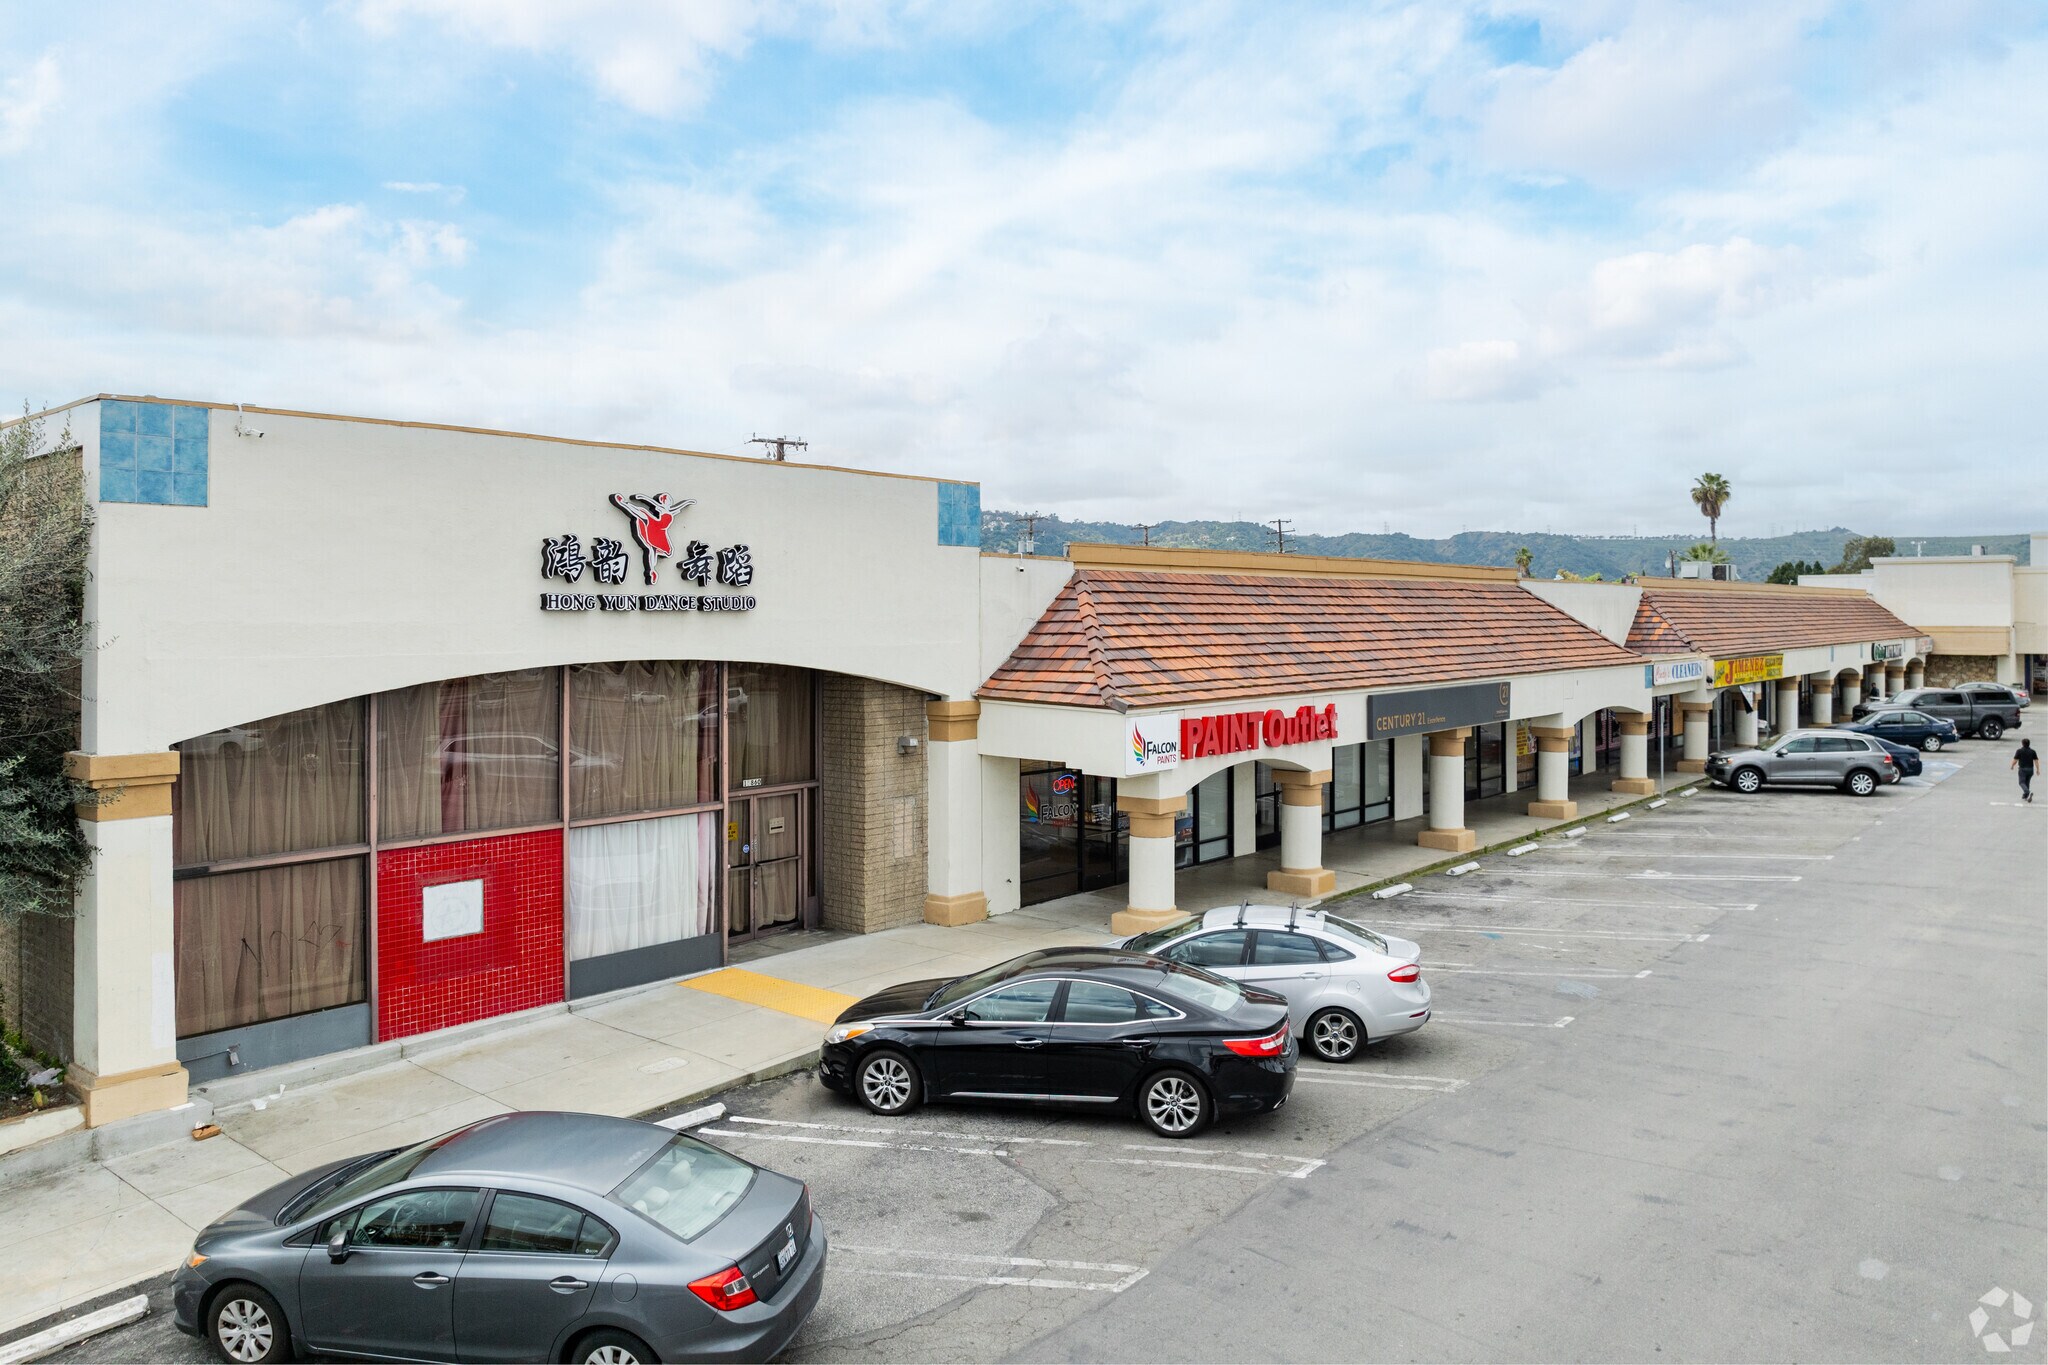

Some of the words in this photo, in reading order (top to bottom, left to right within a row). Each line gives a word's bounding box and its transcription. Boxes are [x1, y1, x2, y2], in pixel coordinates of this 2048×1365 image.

[677, 540, 754, 587] 舞蹈
[545, 593, 597, 610] HONG
[602, 594, 638, 611] YUN
[643, 594, 697, 611] DANCE
[701, 595, 756, 612] STUDIO
[1671, 661, 1703, 680] CLEANERS
[1725, 657, 1764, 684] JIMENEZ
[1376, 712, 1416, 731] CENTURY
[1417, 711, 1427, 726] 21
[1181, 711, 1264, 760] PAINT
[1263, 703, 1338, 748] Outlet
[1146, 741, 1177, 761] FALCON
[1157, 754, 1177, 764] PAINTS
[1052, 778, 1075, 791] OPEN
[1041, 803, 1078, 826] FALCON
